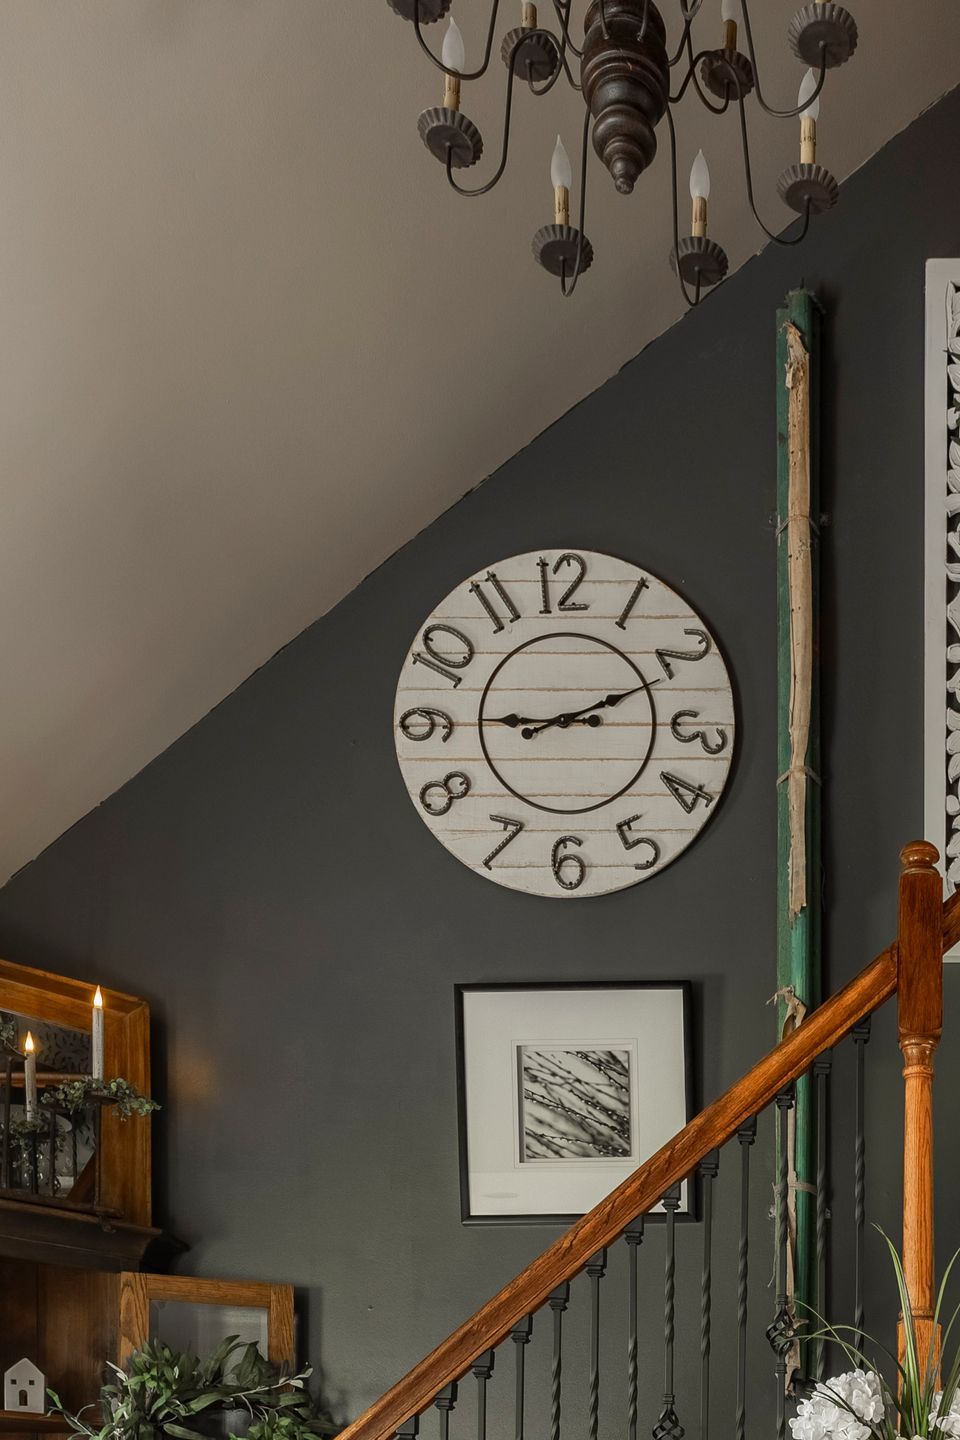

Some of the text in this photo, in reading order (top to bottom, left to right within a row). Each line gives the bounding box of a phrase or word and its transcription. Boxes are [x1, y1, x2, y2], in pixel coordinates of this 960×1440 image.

[468, 571, 520, 633] 11
[536, 553, 589, 613] 12
[615, 577, 648, 629] 1
[411, 624, 474, 687] 10
[655, 629, 711, 679] 2
[399, 707, 453, 742] 9
[670, 710, 726, 754] 3
[419, 771, 471, 815] 8
[659, 771, 712, 813] 4
[482, 815, 524, 869] 7
[551, 836, 585, 890] 6
[615, 814, 660, 869] 5
